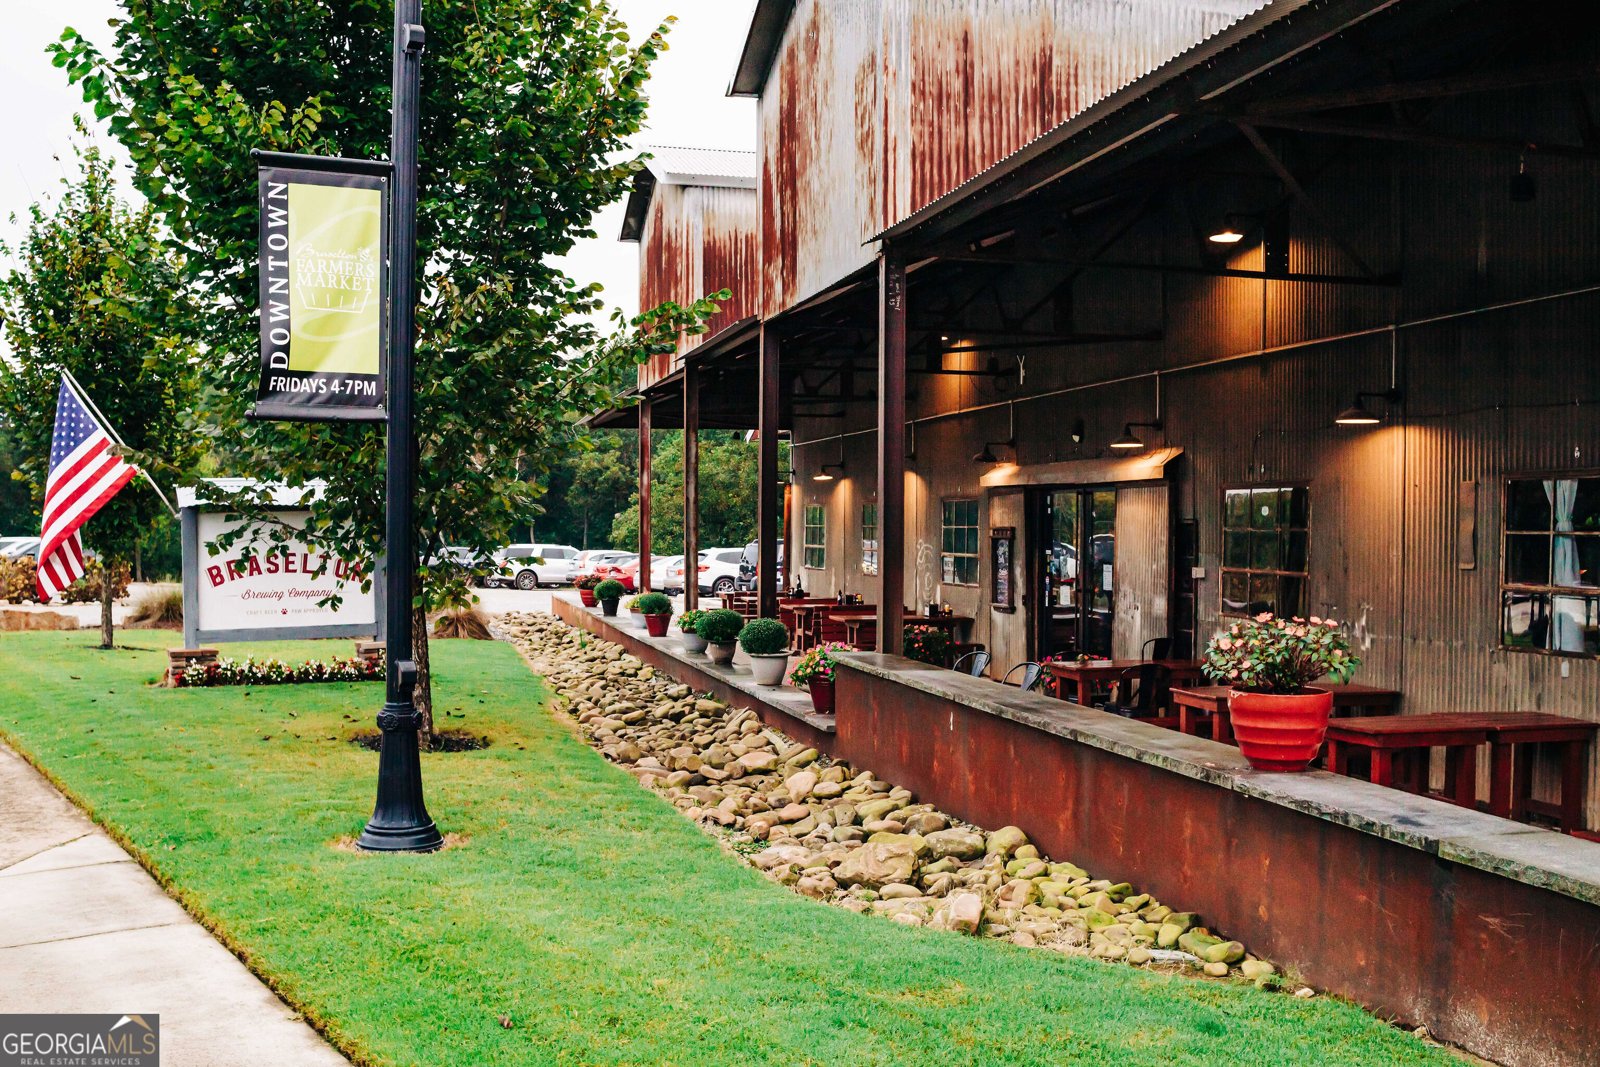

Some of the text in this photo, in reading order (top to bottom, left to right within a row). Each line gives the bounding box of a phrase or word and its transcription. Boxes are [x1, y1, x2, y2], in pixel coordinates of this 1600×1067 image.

[267, 181, 290, 370] DOWNTOWN
[296, 258, 375, 277] FARMERS
[296, 272, 375, 291] MARKET
[269, 376, 376, 396] FRIDAYS 4-7PM
[241, 587, 333, 601] Brewing Company
